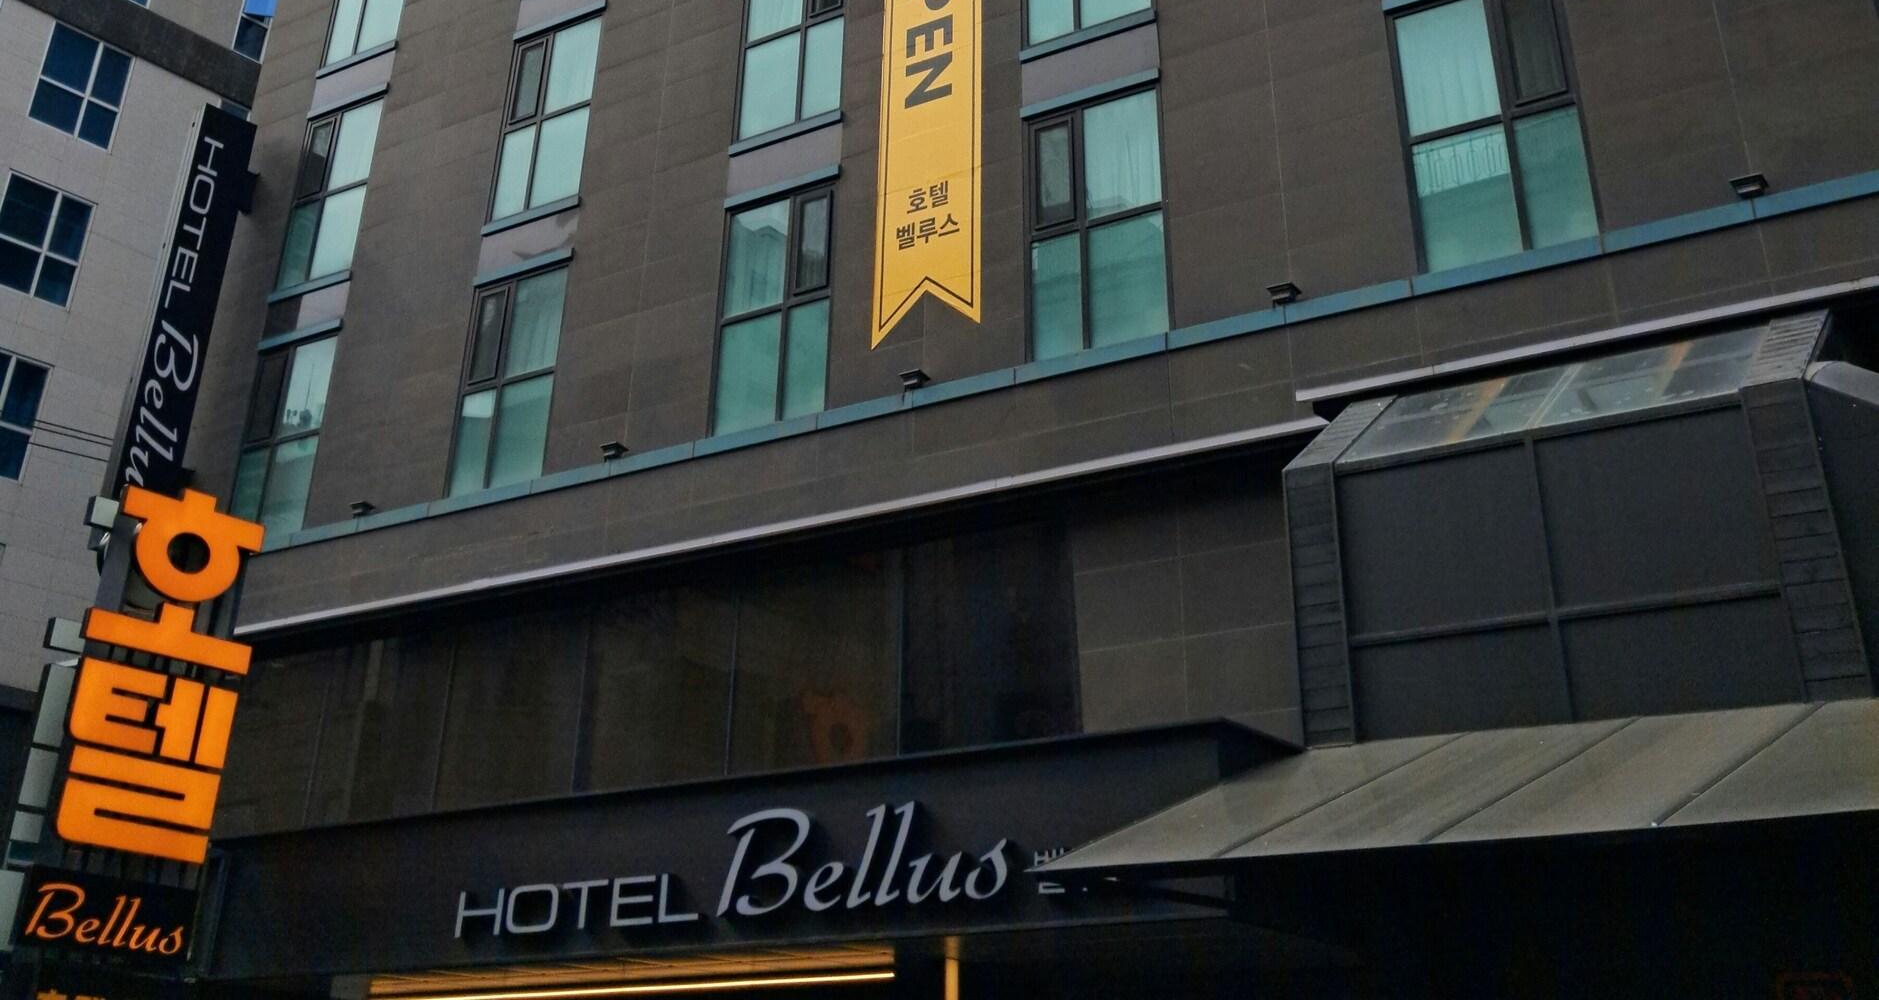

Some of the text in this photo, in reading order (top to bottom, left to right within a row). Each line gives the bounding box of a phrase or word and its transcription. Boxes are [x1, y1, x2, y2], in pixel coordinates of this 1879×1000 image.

[896, 213, 960, 250] 벨루스
[907, 180, 949, 214] 호텔
[124, 136, 225, 487] HOTEL Bellu
[55, 485, 265, 864] 호텔
[25, 882, 184, 955] Bellus
[454, 873, 699, 938] HOTEL
[716, 800, 1009, 918] Bellus
